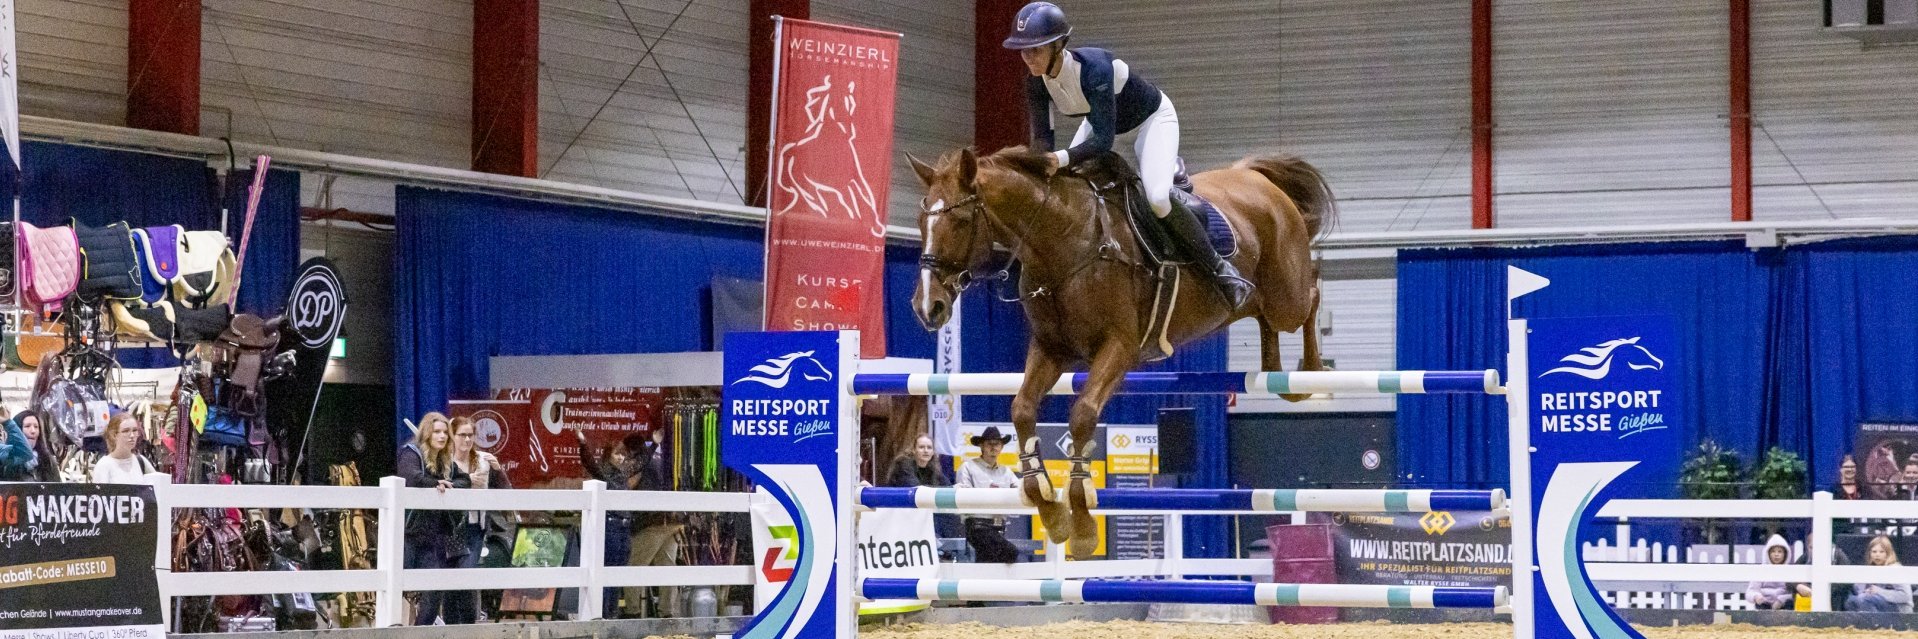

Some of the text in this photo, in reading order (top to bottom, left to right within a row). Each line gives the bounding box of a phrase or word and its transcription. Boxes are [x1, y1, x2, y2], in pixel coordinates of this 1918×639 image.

[790, 38, 890, 62] WEINZIERL
[732, 400, 830, 416] REITSPORT
[1541, 390, 1662, 411] REITSPORT
[732, 419, 831, 438] MESSE Gießen
[1542, 412, 1664, 433] MESSE Gießen
[26, 494, 145, 524] MAKEOVER
[6, 526, 27, 548] für
[28, 522, 100, 546] Pferdefreunde
[66, 560, 107, 577] MESSE10
[1378, 563, 1424, 573] SPEZIALIST
[1445, 565, 1511, 575] REITPLATZSAND
[20, 608, 47, 618] Gelände
[54, 606, 143, 619] www.mustangmakeover.de
